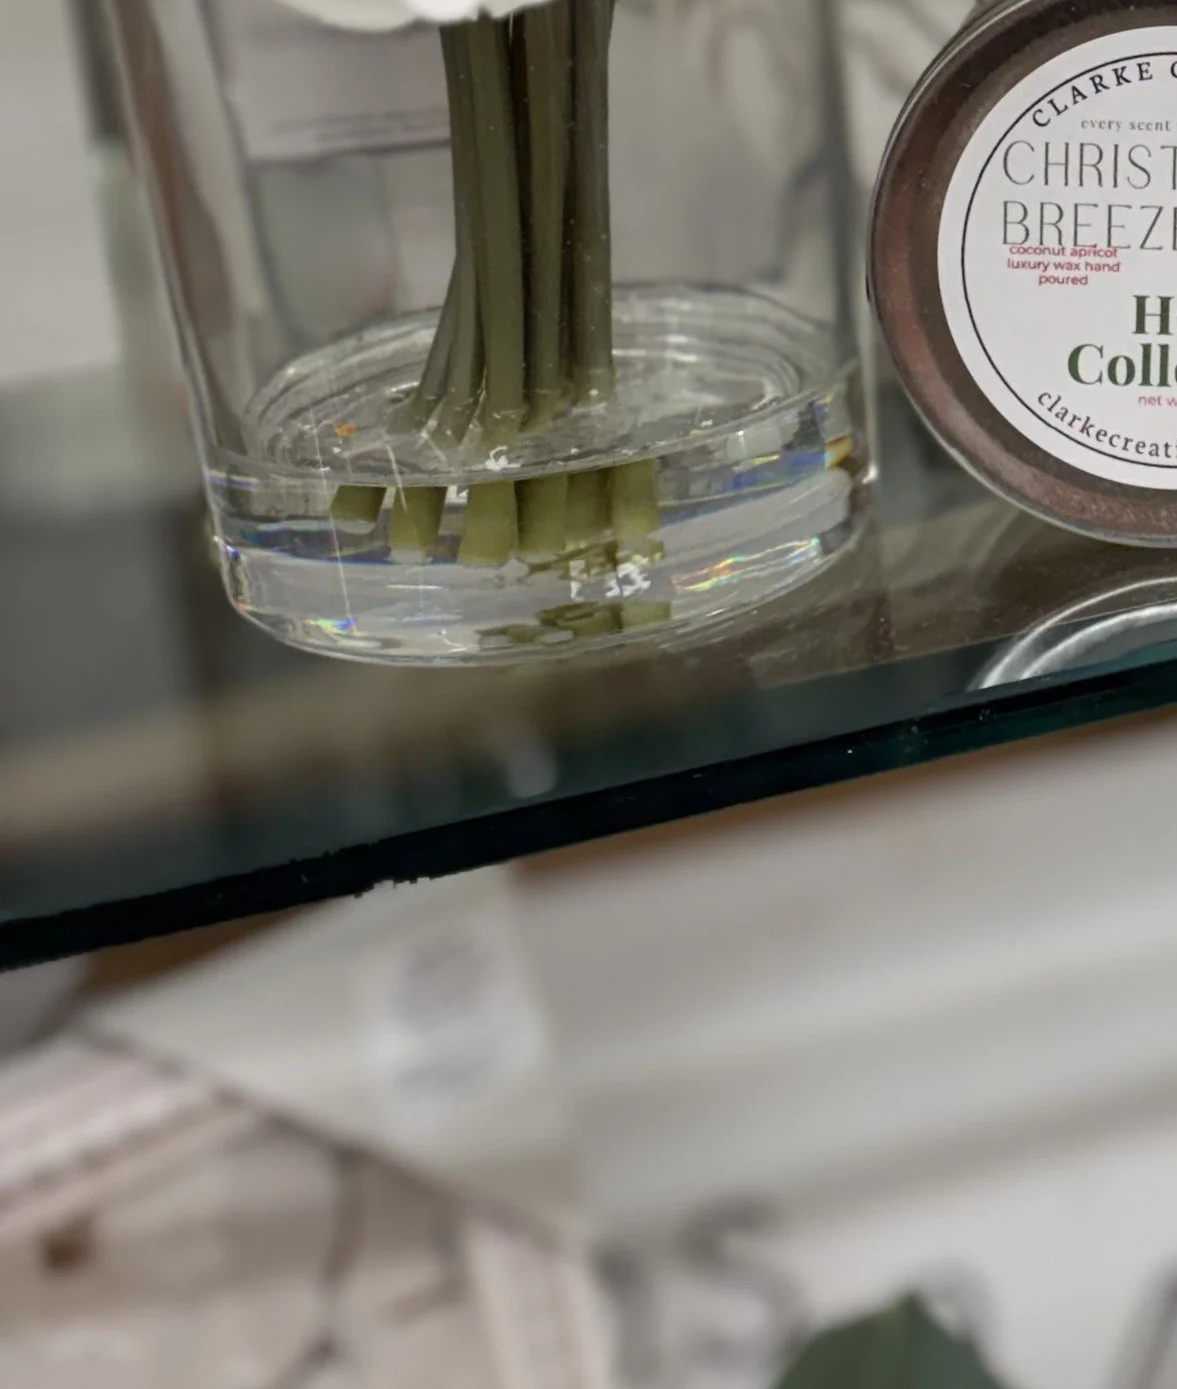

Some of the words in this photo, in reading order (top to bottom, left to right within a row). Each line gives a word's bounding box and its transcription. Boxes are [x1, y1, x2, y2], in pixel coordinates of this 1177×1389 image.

[1032, 60, 1153, 128] CLARKE
[1081, 120, 1121, 132] every
[1129, 120, 1170, 132] scent
[1009, 245, 1066, 257] coconut
[1070, 247, 1118, 259] apricot
[1007, 258, 1049, 272] luxury
[1053, 261, 1080, 271] wax
[1084, 260, 1120, 272] hand
[1038, 274, 1089, 286] poured
[1138, 395, 1162, 407] net
